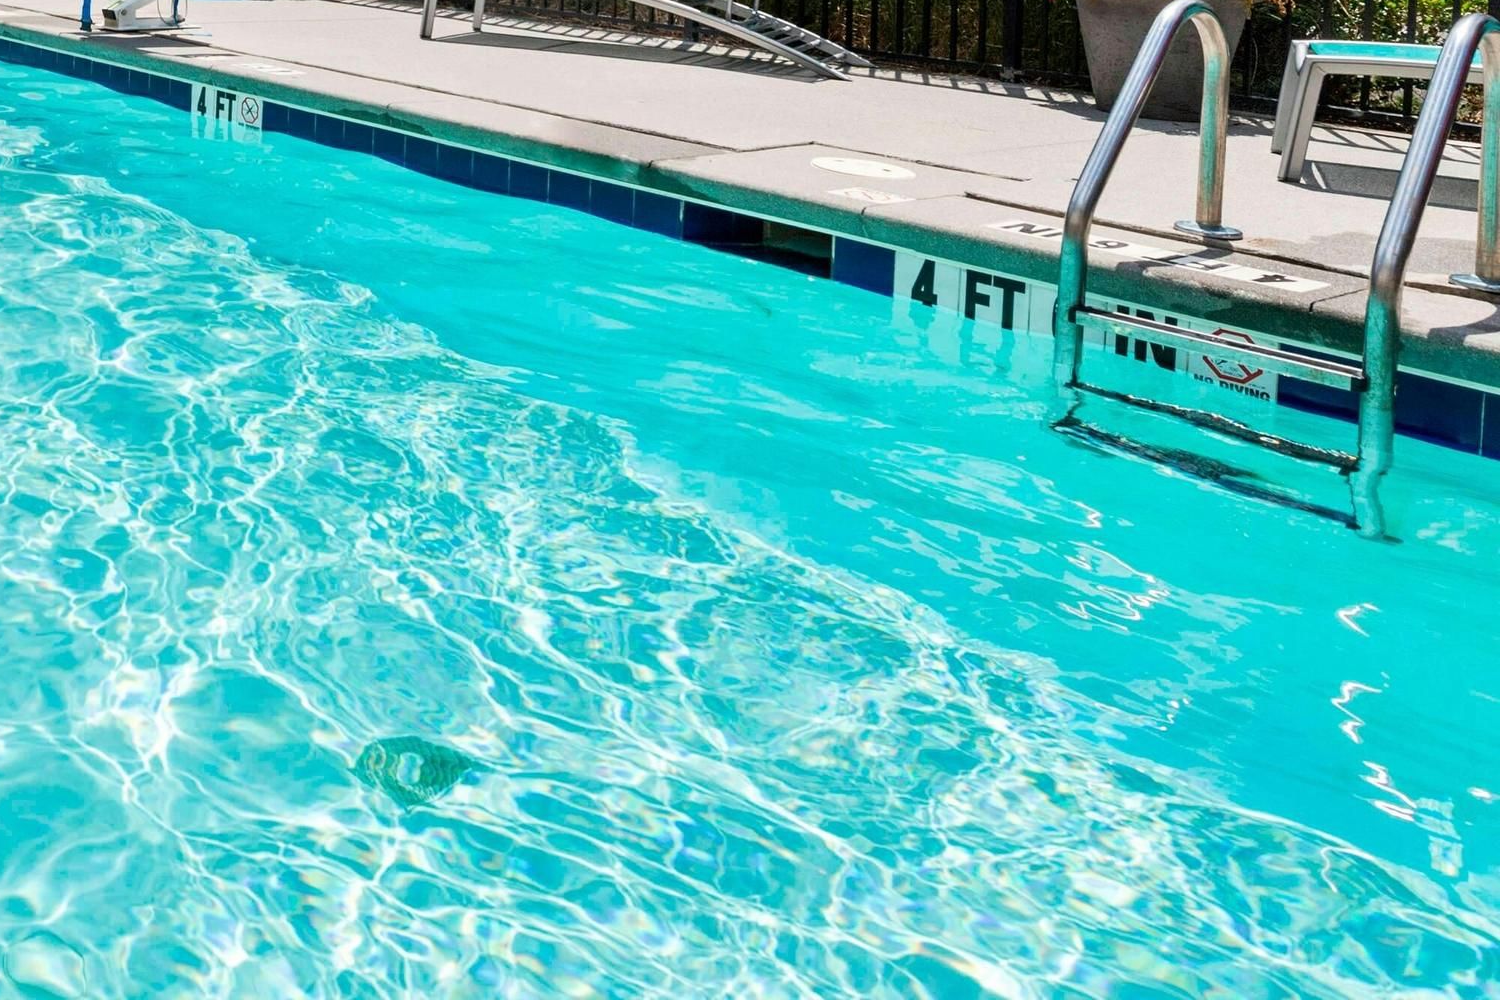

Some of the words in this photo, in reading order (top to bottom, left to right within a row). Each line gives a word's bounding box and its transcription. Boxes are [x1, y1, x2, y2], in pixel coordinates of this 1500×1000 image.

[197, 86, 207, 116] 4
[215, 90, 237, 122] FT
[911, 259, 938, 307] 4
[964, 269, 1026, 331] FT
